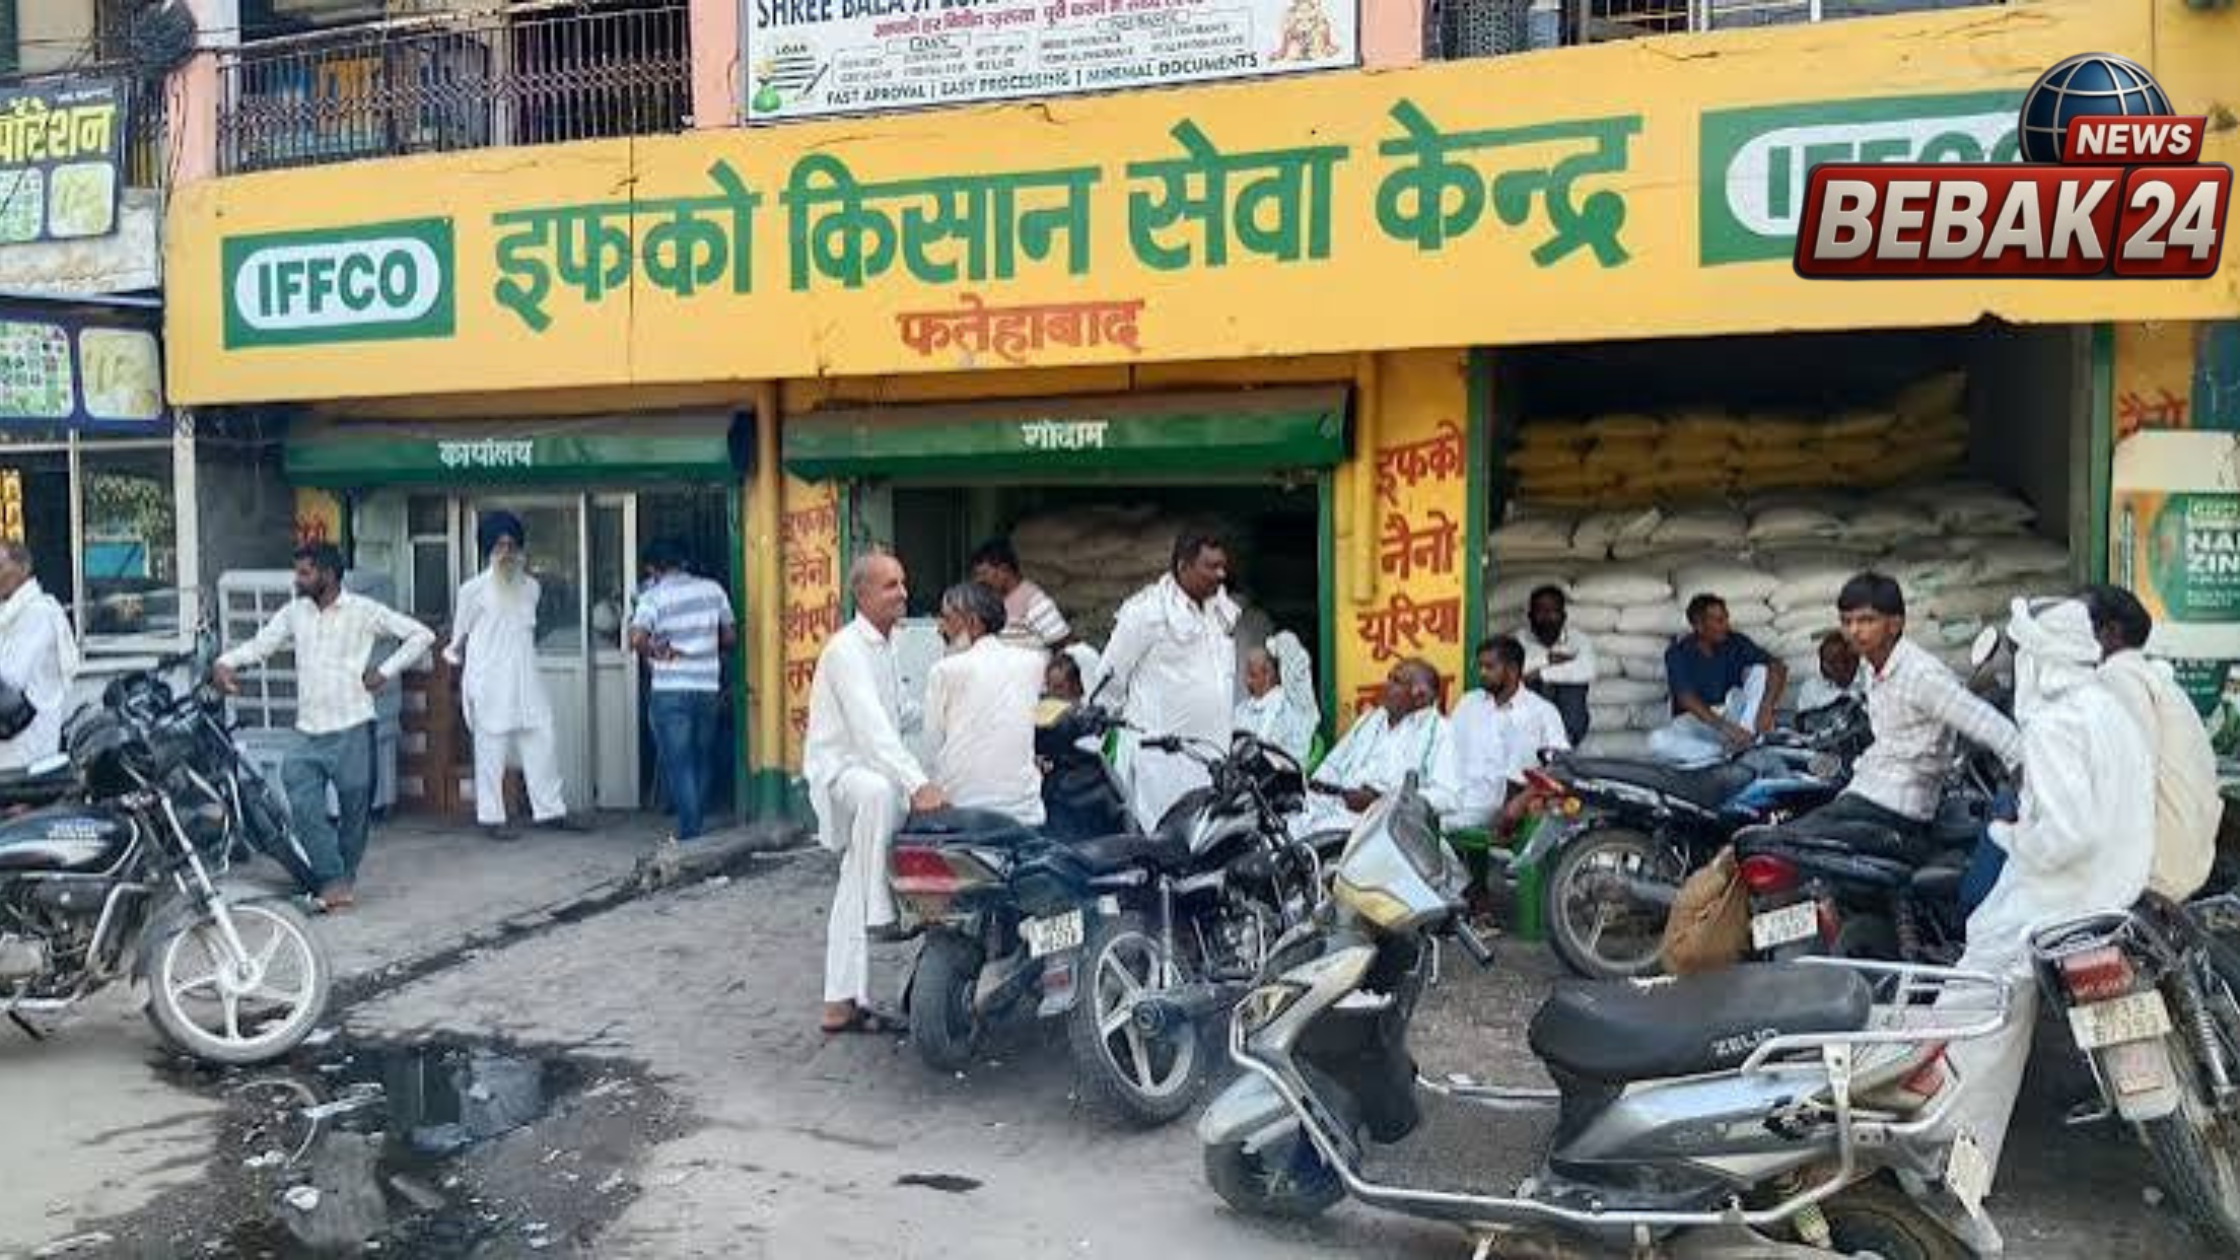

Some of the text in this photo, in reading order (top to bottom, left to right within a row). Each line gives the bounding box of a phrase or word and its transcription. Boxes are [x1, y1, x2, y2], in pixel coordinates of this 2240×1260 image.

[1158, 51, 1259, 77] DOCUMENTS
[494, 160, 761, 332] इफको
[781, 153, 1102, 292] किसान
[1127, 120, 1349, 271] सेवा
[1375, 101, 1644, 269] केन्द्र
[257, 249, 419, 316] IFFCO
[897, 295, 1145, 360] फतेहाबाद
[438, 437, 534, 469] कार्यालय
[1021, 418, 1109, 451] गोदाम
[1375, 419, 1465, 507] इफको
[1381, 510, 1459, 580] नैनो
[2186, 530, 2240, 553] NA
[1356, 591, 1461, 661] यूरिया
